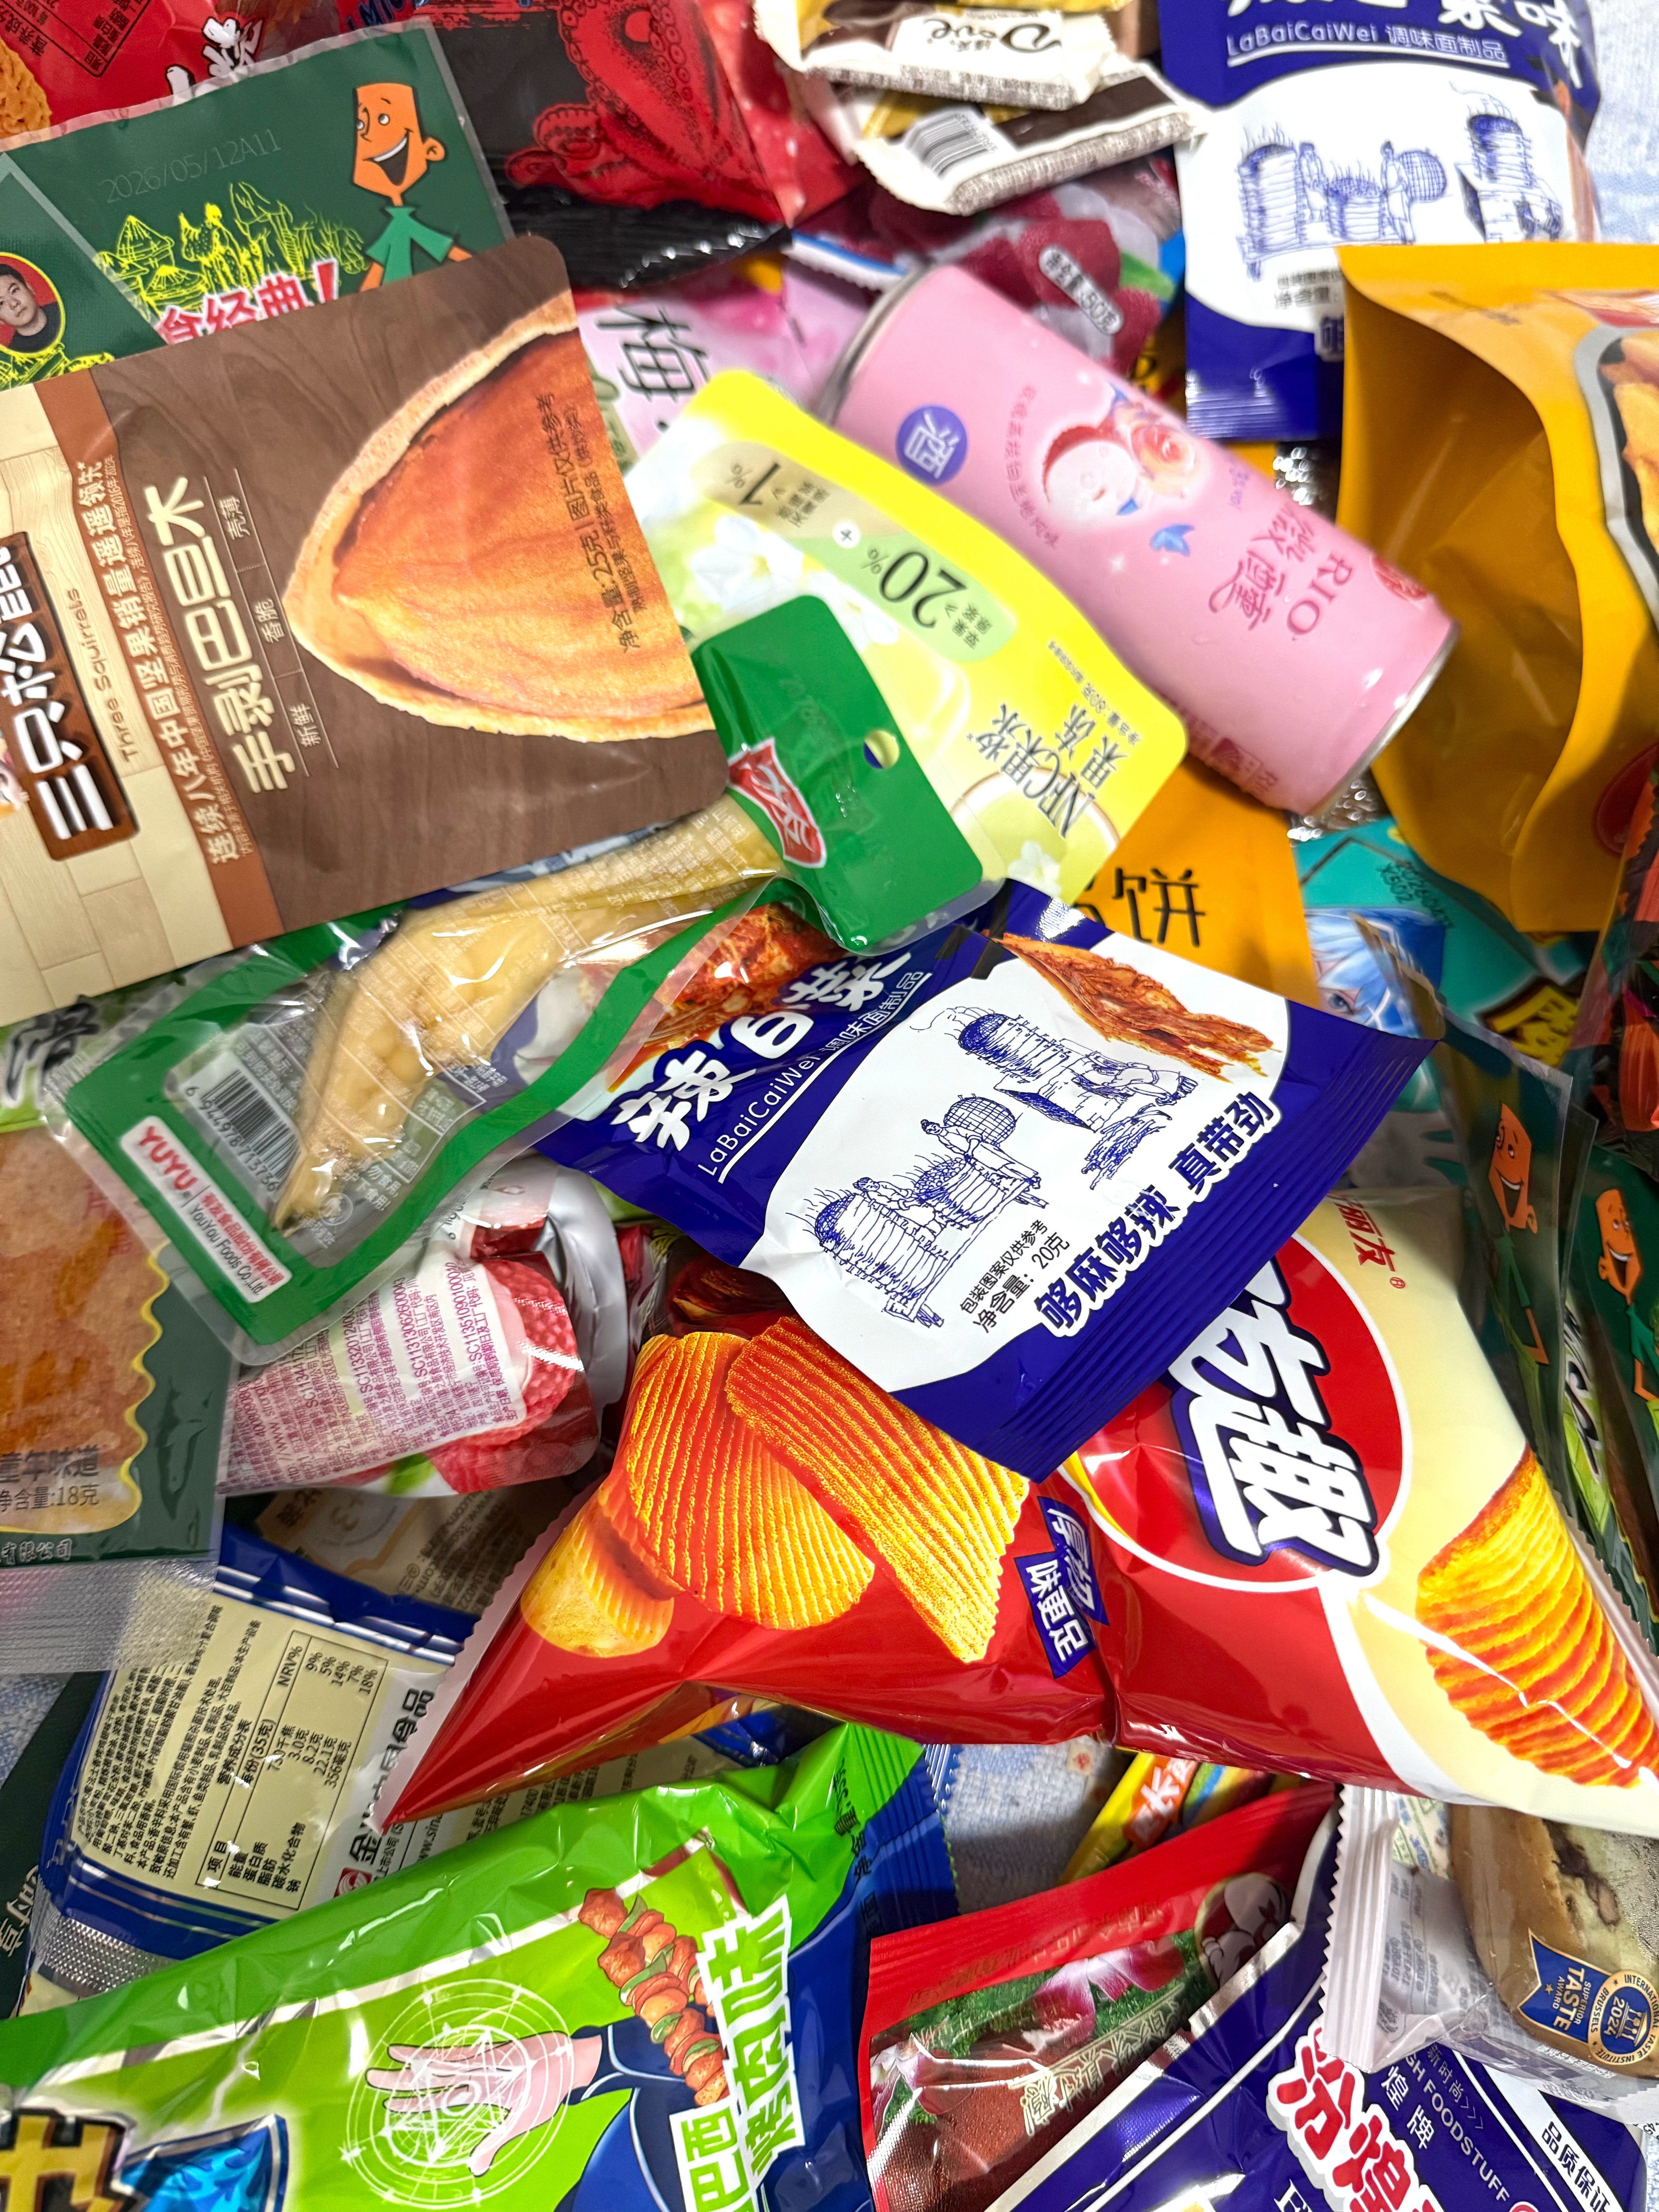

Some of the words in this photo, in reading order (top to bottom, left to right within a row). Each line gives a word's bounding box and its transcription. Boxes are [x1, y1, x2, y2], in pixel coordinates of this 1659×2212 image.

[1226, 21, 1379, 57] LaBaiCaiWei
[1385, 25, 1506, 61] 调味面制品
[219, 495, 251, 540] 壳薄
[144, 477, 295, 793] 手剥巴旦木
[254, 598, 285, 644] 香脆
[1286, 551, 1353, 636] RIO
[65, 587, 112, 692] Squirrels
[105, 698, 139, 764] Three
[287, 703, 321, 748] 新鲜
[1054, 704, 1128, 789] 果冻
[697, 1056, 820, 1178] LaBaiCaiWei
[821, 970, 924, 1054] 调味面制品
[134, 1124, 199, 1195] YUYU
[197, 1190, 285, 1289] 有友食品股份有限公司
[187, 1204, 224, 1244] YouYou
[213, 1237, 246, 1271] Foods
[1033, 1183, 1182, 1331] 够麻够辣
[1168, 1091, 1273, 1194] 真带劲
[960, 1219, 1049, 1314] 包装图案仅供参考
[1025, 1558, 1089, 1664] 味更足
[275, 1643, 304, 1688] NRV%
[216, 1716, 254, 1787] 营养成分表
[227, 1848, 249, 1879] 能量
[305, 1649, 323, 1672] 9%
[242, 1839, 268, 1883] 蛋白质
[287, 1726, 310, 1761] 3.0克
[319, 1654, 337, 1676] 5%
[256, 1856, 278, 1887] 脂肪
[301, 1730, 325, 1765] 8.2克
[330, 1658, 351, 1687] 14%
[271, 1820, 307, 1891] 碳水化合物
[313, 1734, 339, 1777] 22.1克
[347, 1662, 365, 1684] 7%
[285, 1877, 303, 1894] 钠
[324, 1738, 353, 1790] 356毫克
[358, 1667, 379, 1695] 18%
[1550, 1976, 1566, 2011] AWARD
[1551, 1966, 1586, 2030] TASTE
[1573, 1980, 1592, 2025] SUPERIOR
[1590, 1988, 1609, 2033] BRUSSELS
[1602, 1995, 1626, 2037] 2024
[1422, 2081, 1510, 2204] FOODSTUFF
